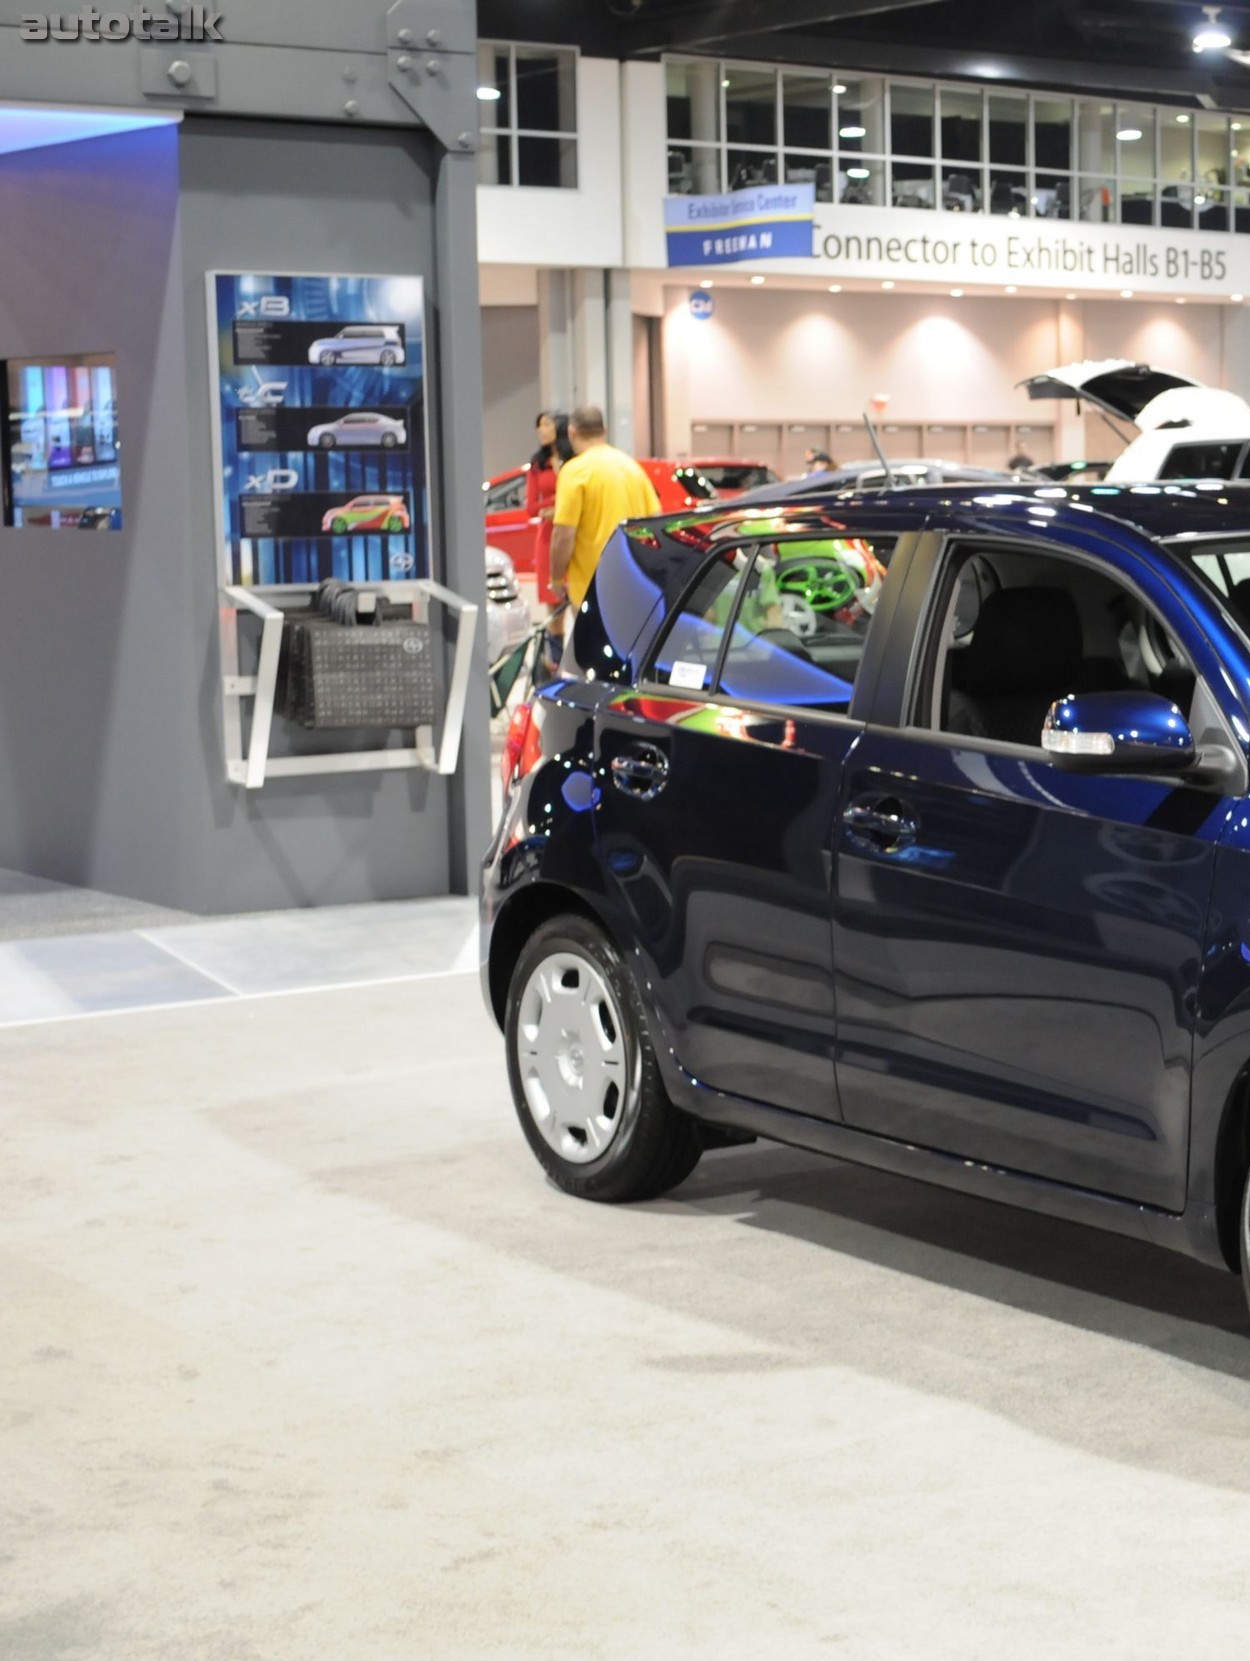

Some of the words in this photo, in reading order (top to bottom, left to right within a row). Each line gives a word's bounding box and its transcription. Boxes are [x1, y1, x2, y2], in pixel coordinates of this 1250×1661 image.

[970, 237, 997, 267] to
[1006, 236, 1095, 273] Exhibit
[1103, 242, 1159, 277] Halls
[1165, 246, 1227, 281] B1-B5
[244, 468, 299, 490] xD
